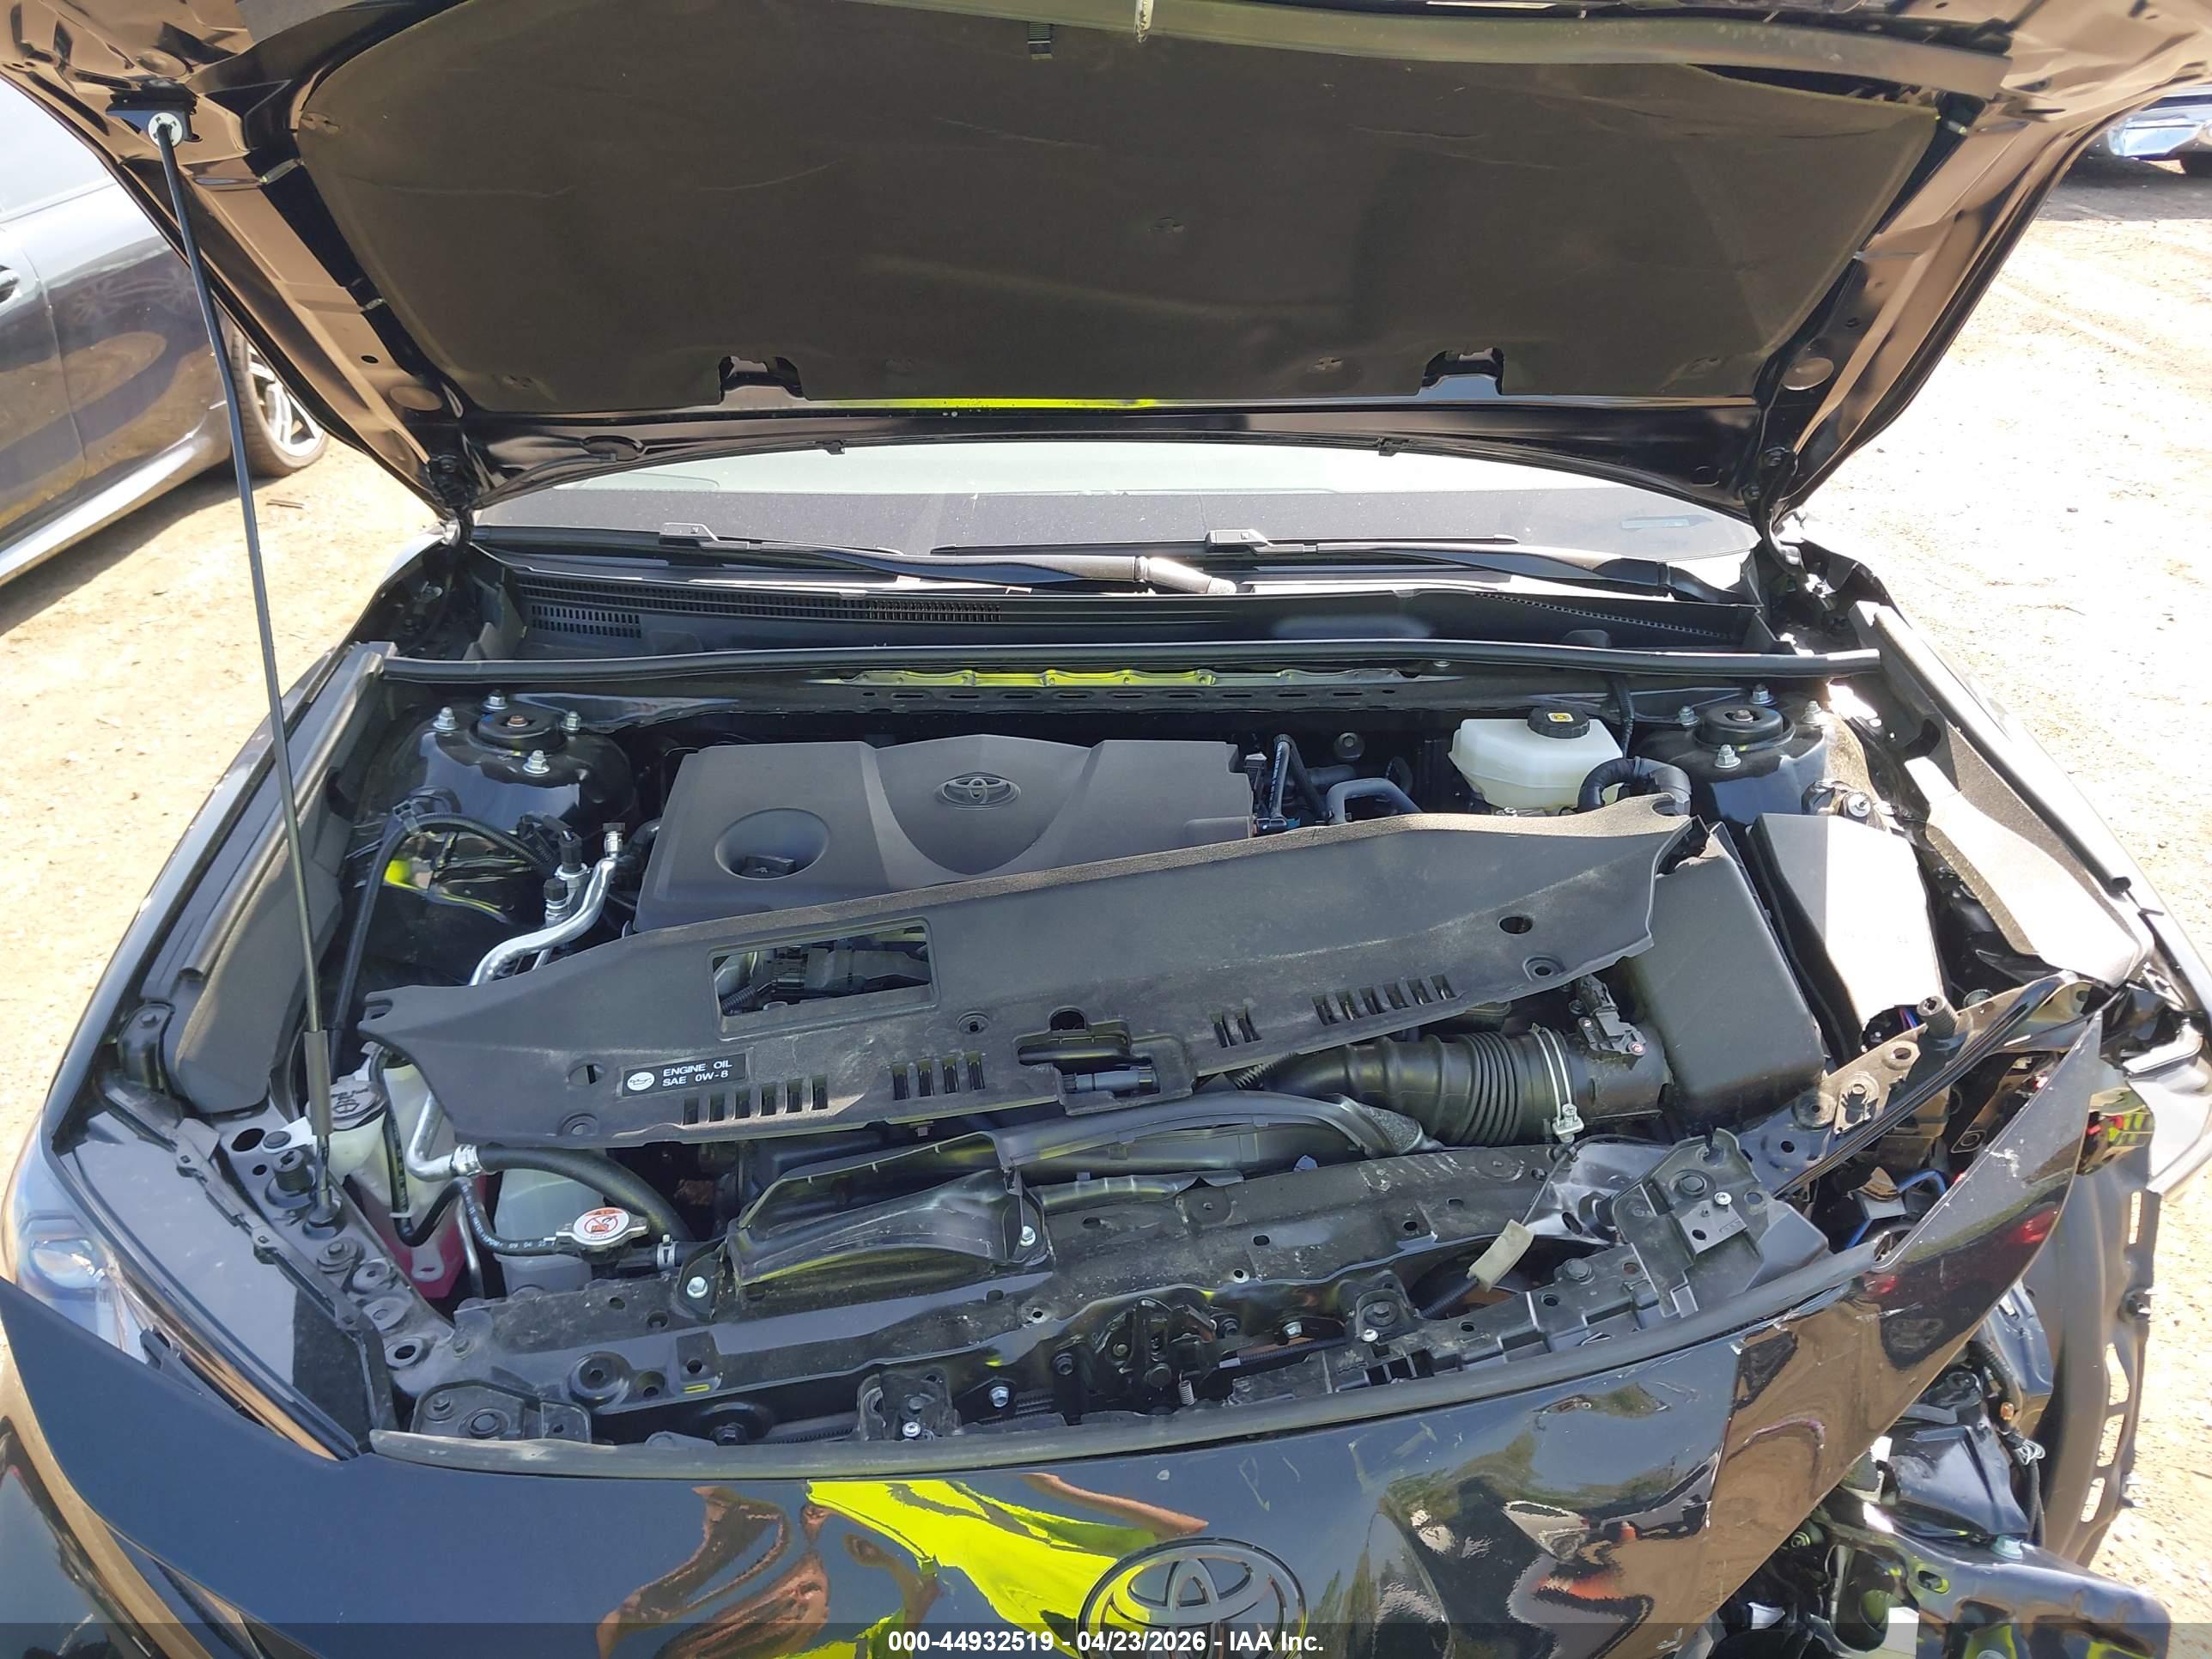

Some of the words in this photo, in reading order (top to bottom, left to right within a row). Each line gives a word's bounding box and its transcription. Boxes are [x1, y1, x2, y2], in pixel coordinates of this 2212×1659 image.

[663, 1063, 707, 1077] ENGINE
[714, 1060, 732, 1069] OIL
[662, 1076, 687, 1087] SAE
